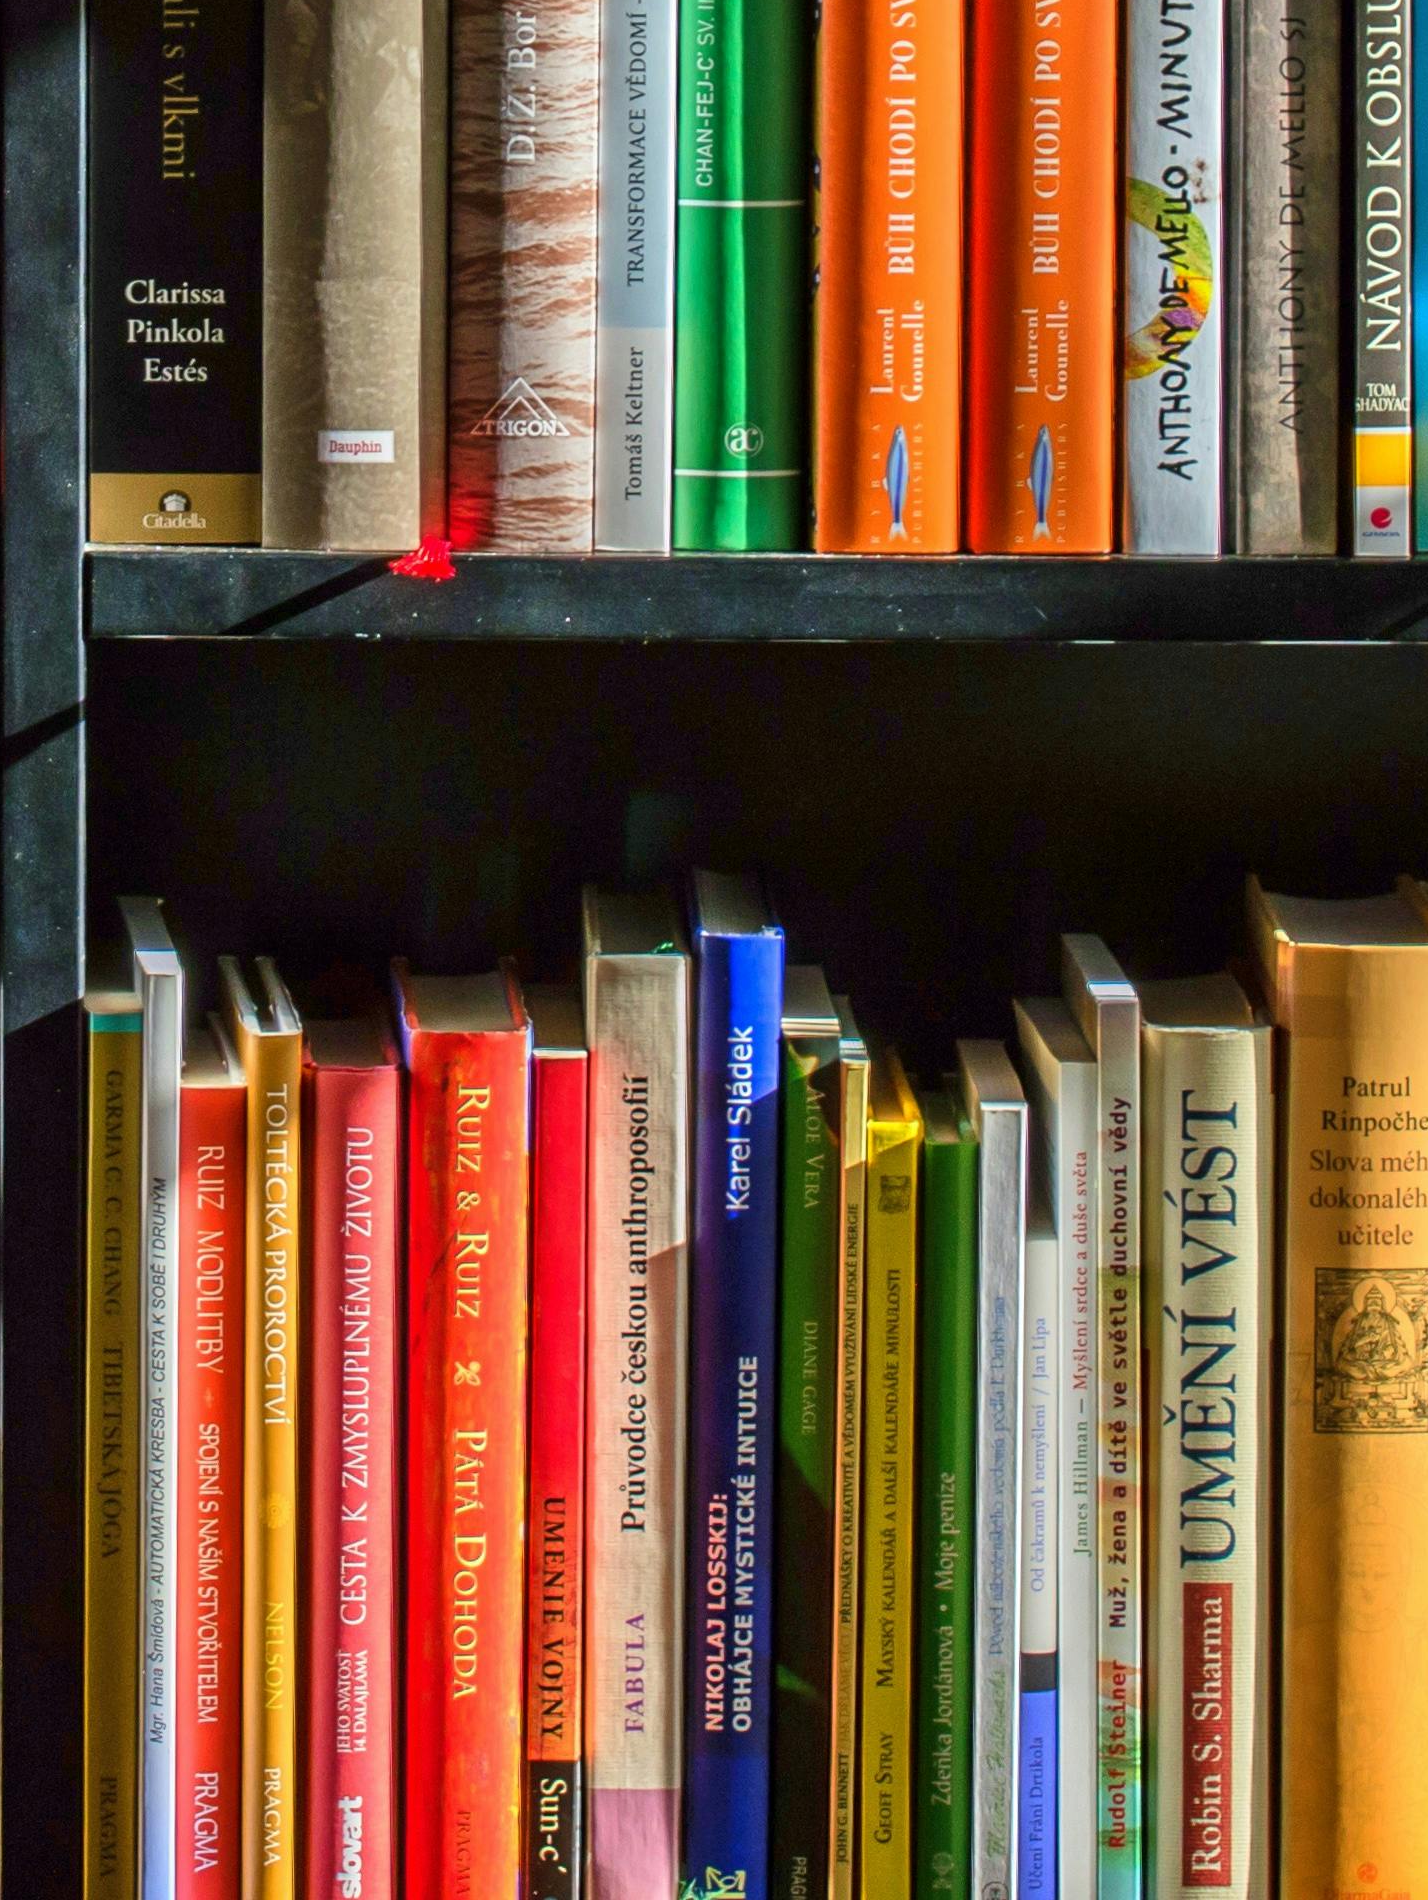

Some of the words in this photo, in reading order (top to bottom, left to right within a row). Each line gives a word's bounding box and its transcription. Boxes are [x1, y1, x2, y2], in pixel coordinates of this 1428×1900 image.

[623, 11, 648, 101] VĚDOMÍ
[888, 40, 917, 80] PO
[885, 95, 917, 197] CHODÍ
[1368, 135, 1403, 167] K
[626, 107, 647, 287] TRANSFORMACE
[883, 212, 917, 274] BŮH
[123, 283, 227, 305] Clarissa
[1358, 186, 1404, 351] NÁVOD
[126, 322, 225, 343] Pinkola
[142, 361, 208, 381] Estés
[623, 345, 644, 425] Keltner
[623, 432, 643, 500] Tomáš
[724, 1025, 756, 1125] Sládek
[341, 1126, 376, 1236] ŽIVOTU
[619, 1073, 653, 1274] anthroposofií
[723, 1135, 754, 1211] Karel
[1165, 1087, 1240, 1284] VÉST
[341, 1252, 373, 1488] ZMYSLUPLNÉMU
[617, 1283, 650, 1385] českou
[616, 1393, 650, 1532] Průvodce
[1163, 1299, 1240, 1567] UMĚNÍ
[342, 1501, 370, 1521] K
[340, 1537, 370, 1624] CESTA
[623, 1612, 646, 1732] FABULA
[1191, 1594, 1227, 1721] Sharma
[1193, 1733, 1225, 1761] S.
[1190, 1774, 1225, 1872] Robin
